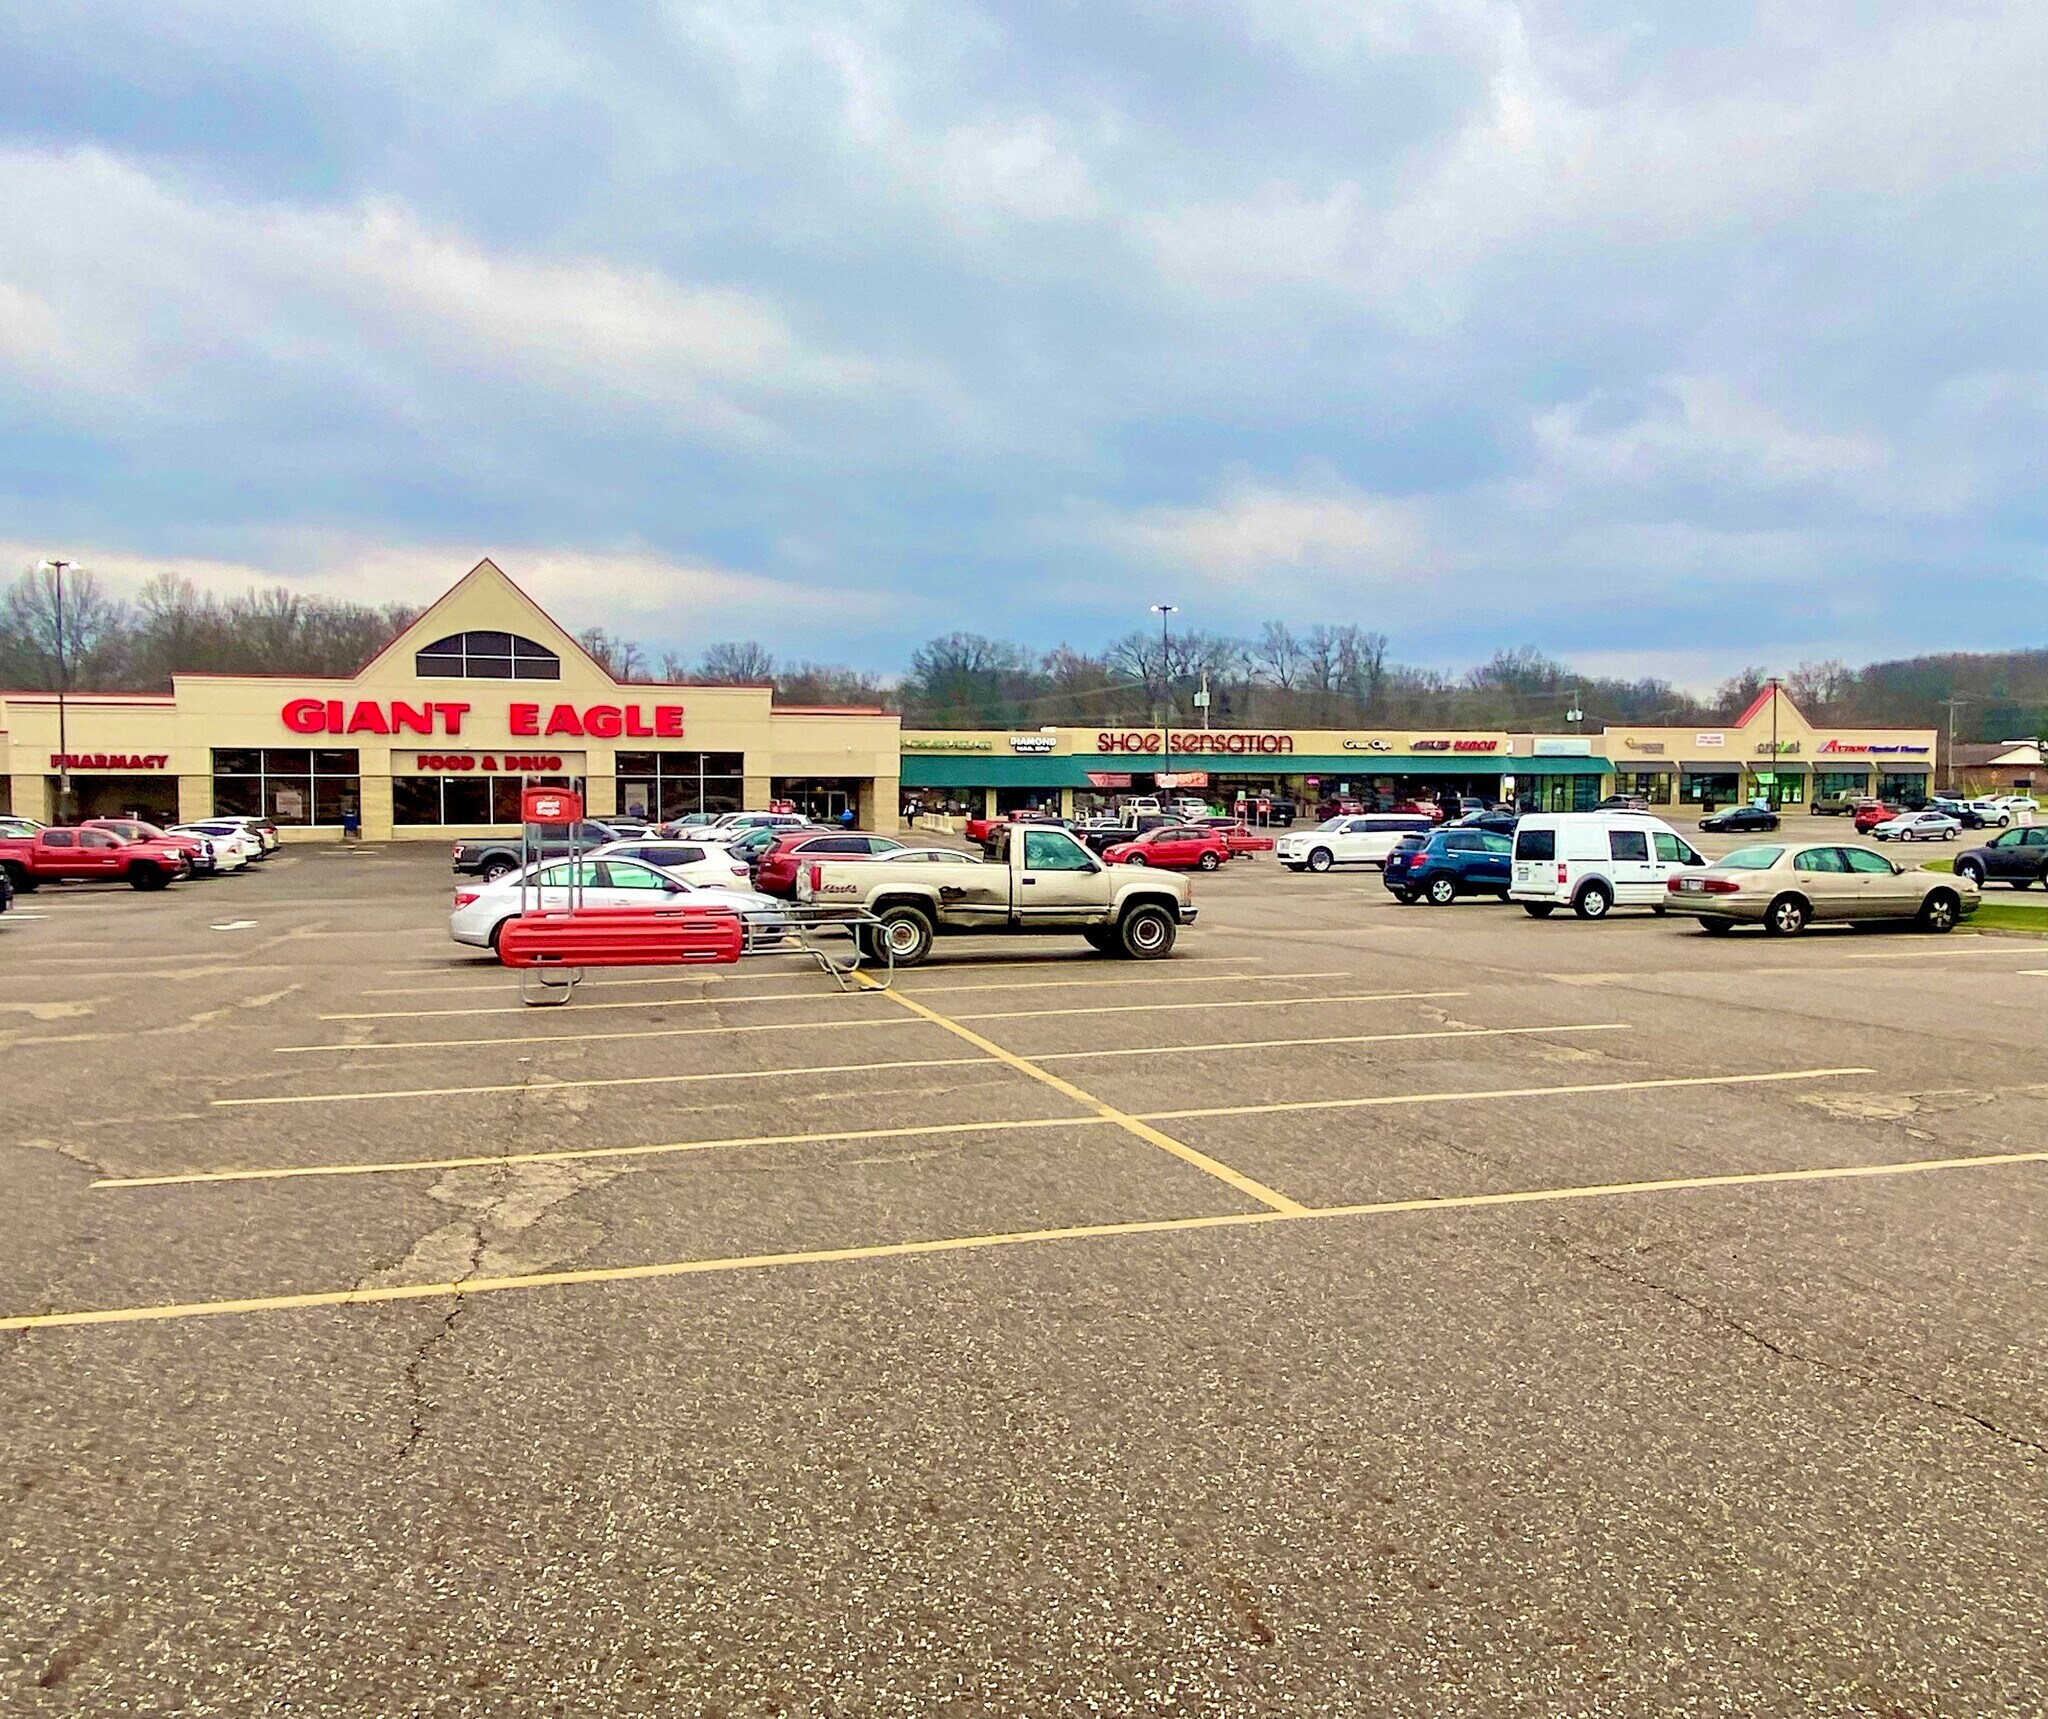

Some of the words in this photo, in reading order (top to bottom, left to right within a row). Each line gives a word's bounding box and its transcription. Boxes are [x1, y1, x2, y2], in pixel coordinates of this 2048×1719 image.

[282, 699, 470, 734] GIANT
[510, 703, 683, 737] EAGLE
[1010, 736, 1057, 746] DIAMOND
[51, 754, 168, 769] PHARMACY
[417, 755, 475, 770] FOOD
[481, 755, 498, 770] &
[505, 756, 562, 770] DRUG
